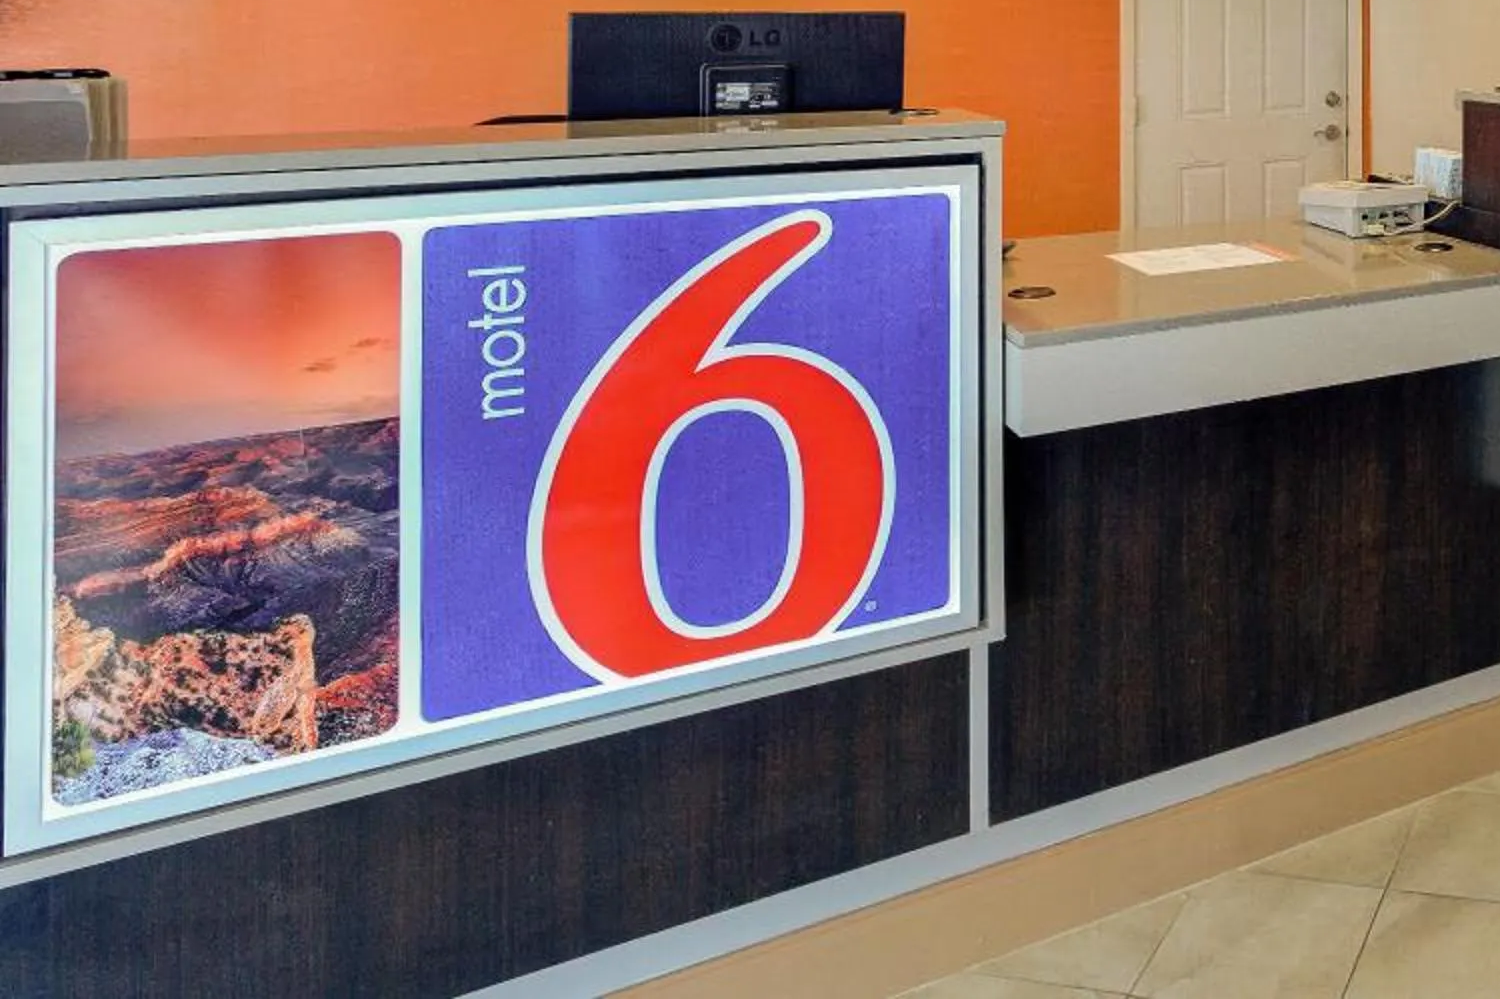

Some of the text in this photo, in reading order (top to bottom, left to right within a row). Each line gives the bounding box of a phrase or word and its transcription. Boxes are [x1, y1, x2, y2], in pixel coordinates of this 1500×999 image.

[749, 29, 781, 46] LG
[467, 265, 527, 419] motel
[526, 208, 897, 685] 6
